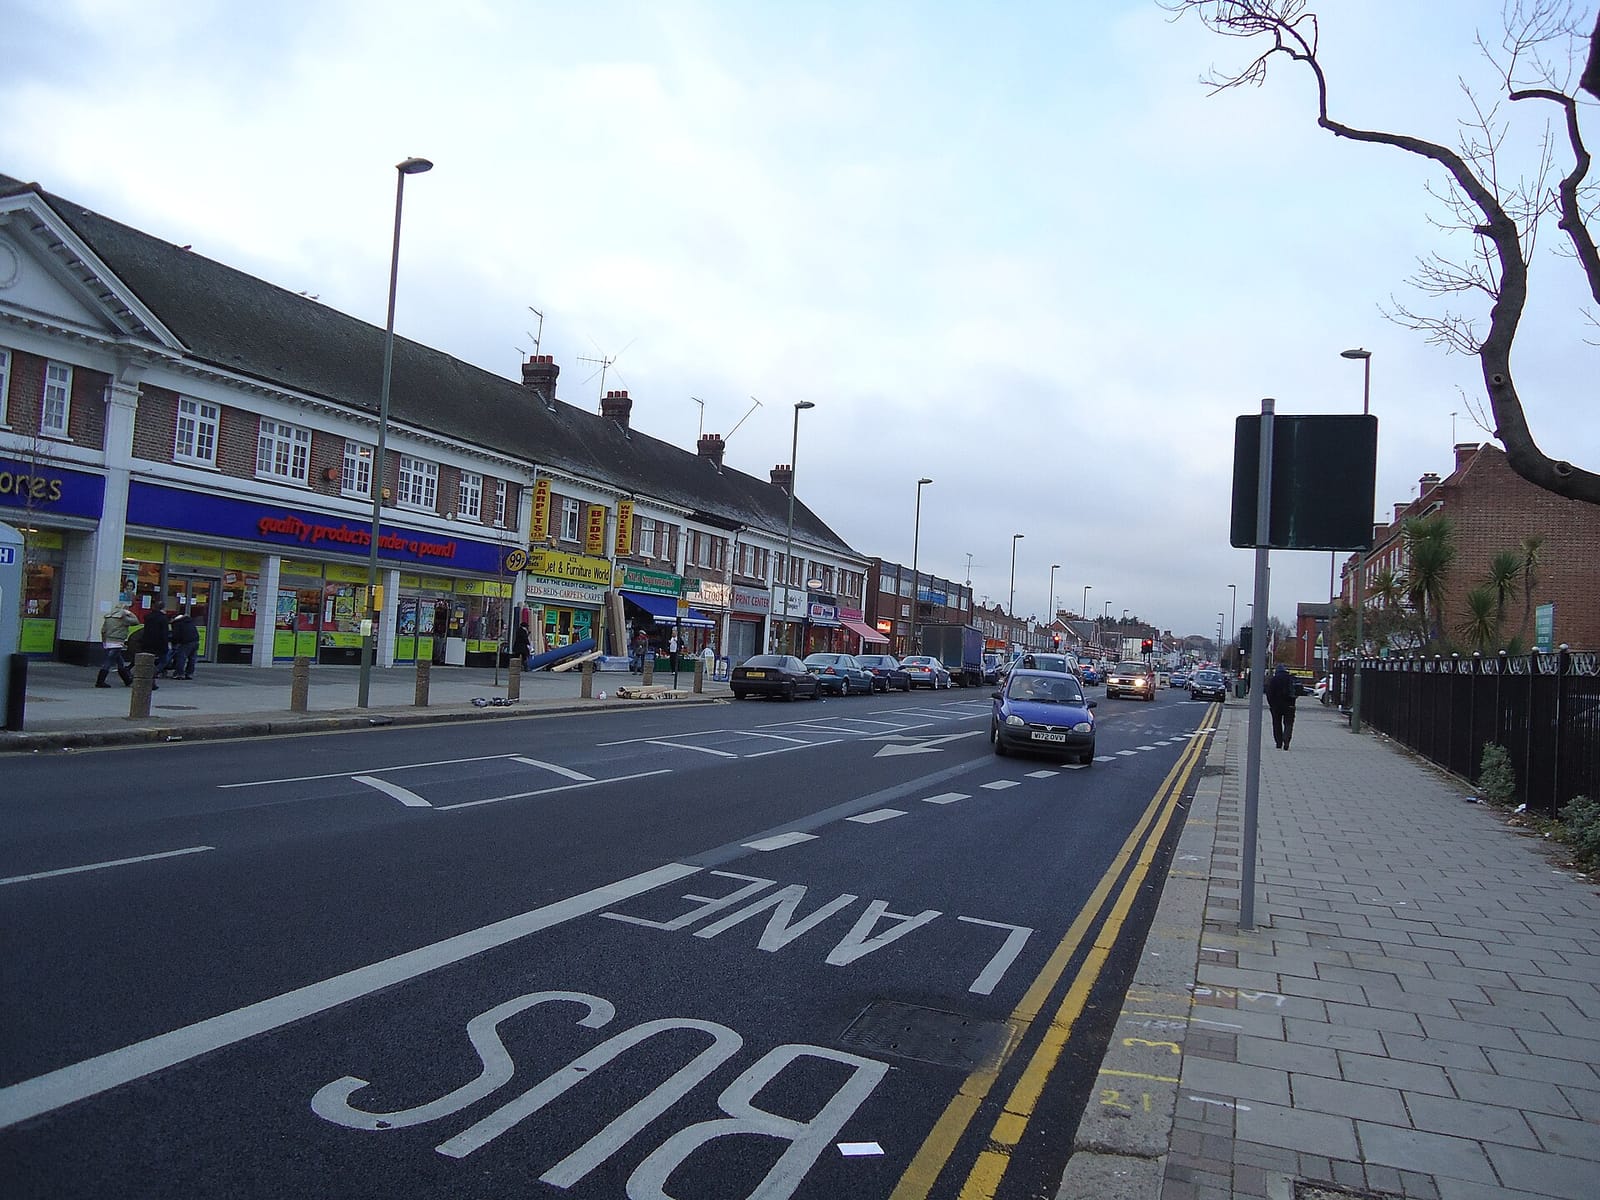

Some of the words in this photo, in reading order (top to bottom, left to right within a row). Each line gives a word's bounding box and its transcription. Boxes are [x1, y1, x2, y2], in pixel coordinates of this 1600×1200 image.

[533, 481, 548, 532] CARPETS
[258, 515, 311, 541] quality
[312, 523, 371, 546] products
[409, 542, 418, 552] a
[419, 542, 456, 558] pound!
[589, 510, 602, 540] BEDS
[561, 580, 579, 588] CREDIT
[566, 563, 592, 577] Furniture
[593, 567, 609, 580] World
[735, 593, 750, 606] PRINT
[751, 595, 770, 608] CENTER
[598, 869, 1035, 995] LANE
[310, 990, 894, 1200] BUS
